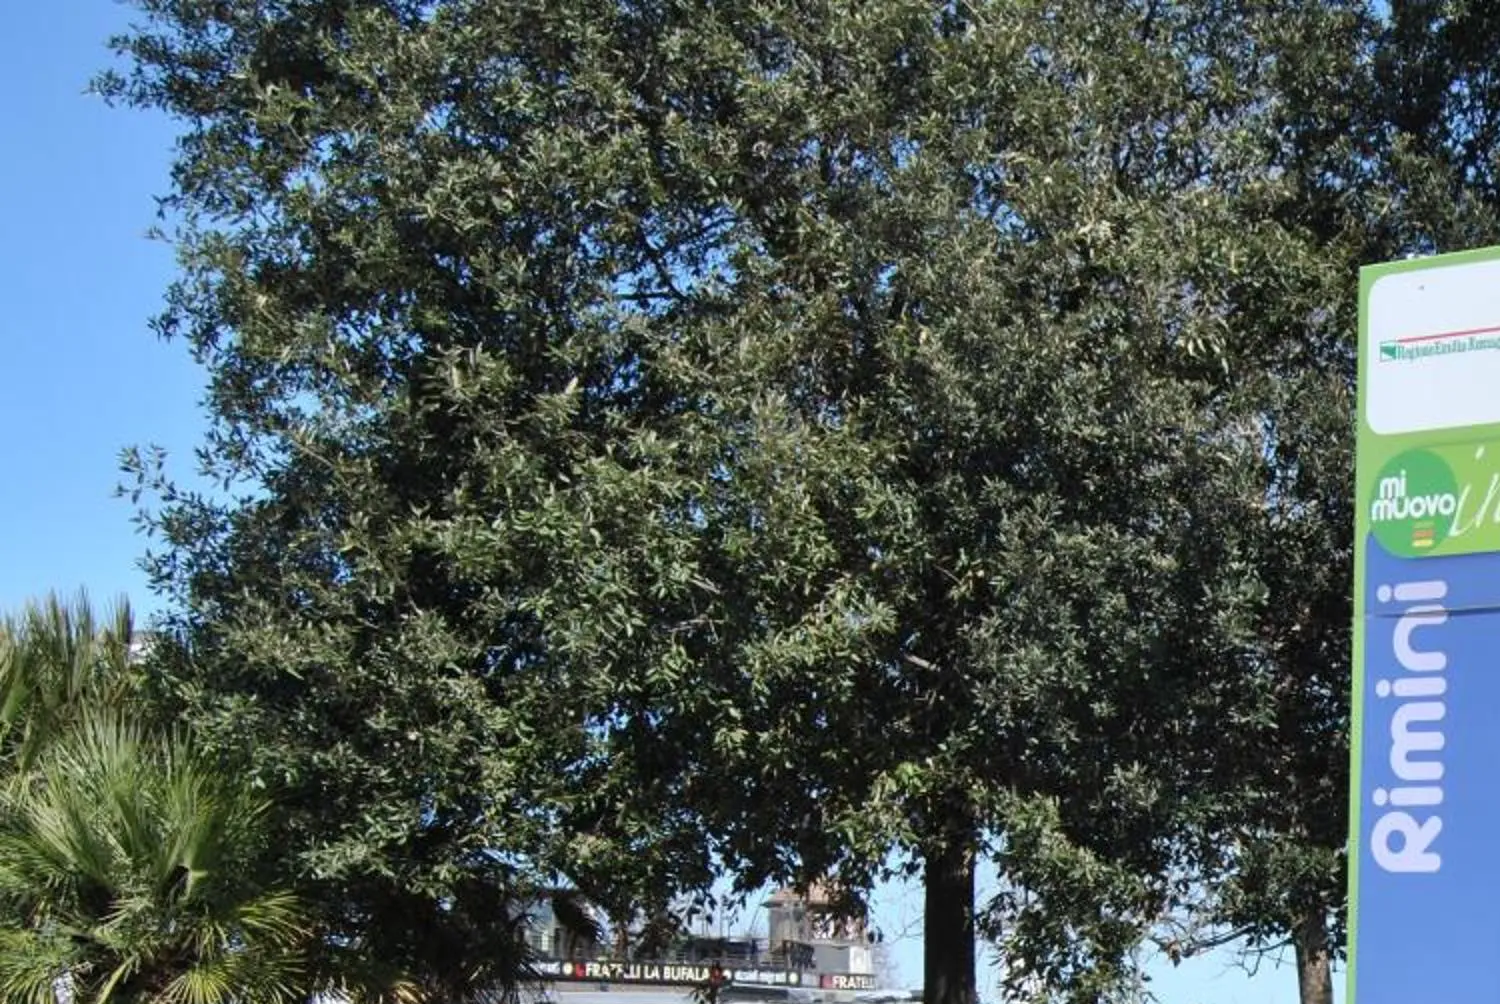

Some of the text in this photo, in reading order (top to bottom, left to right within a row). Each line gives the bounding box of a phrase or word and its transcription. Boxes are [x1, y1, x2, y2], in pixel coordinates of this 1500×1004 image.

[1379, 469, 1407, 498] mi
[1371, 493, 1456, 521] muovo
[1370, 580, 1448, 873] Rimini
[644, 964, 660, 980] LA
[663, 965, 710, 981] BUFALA
